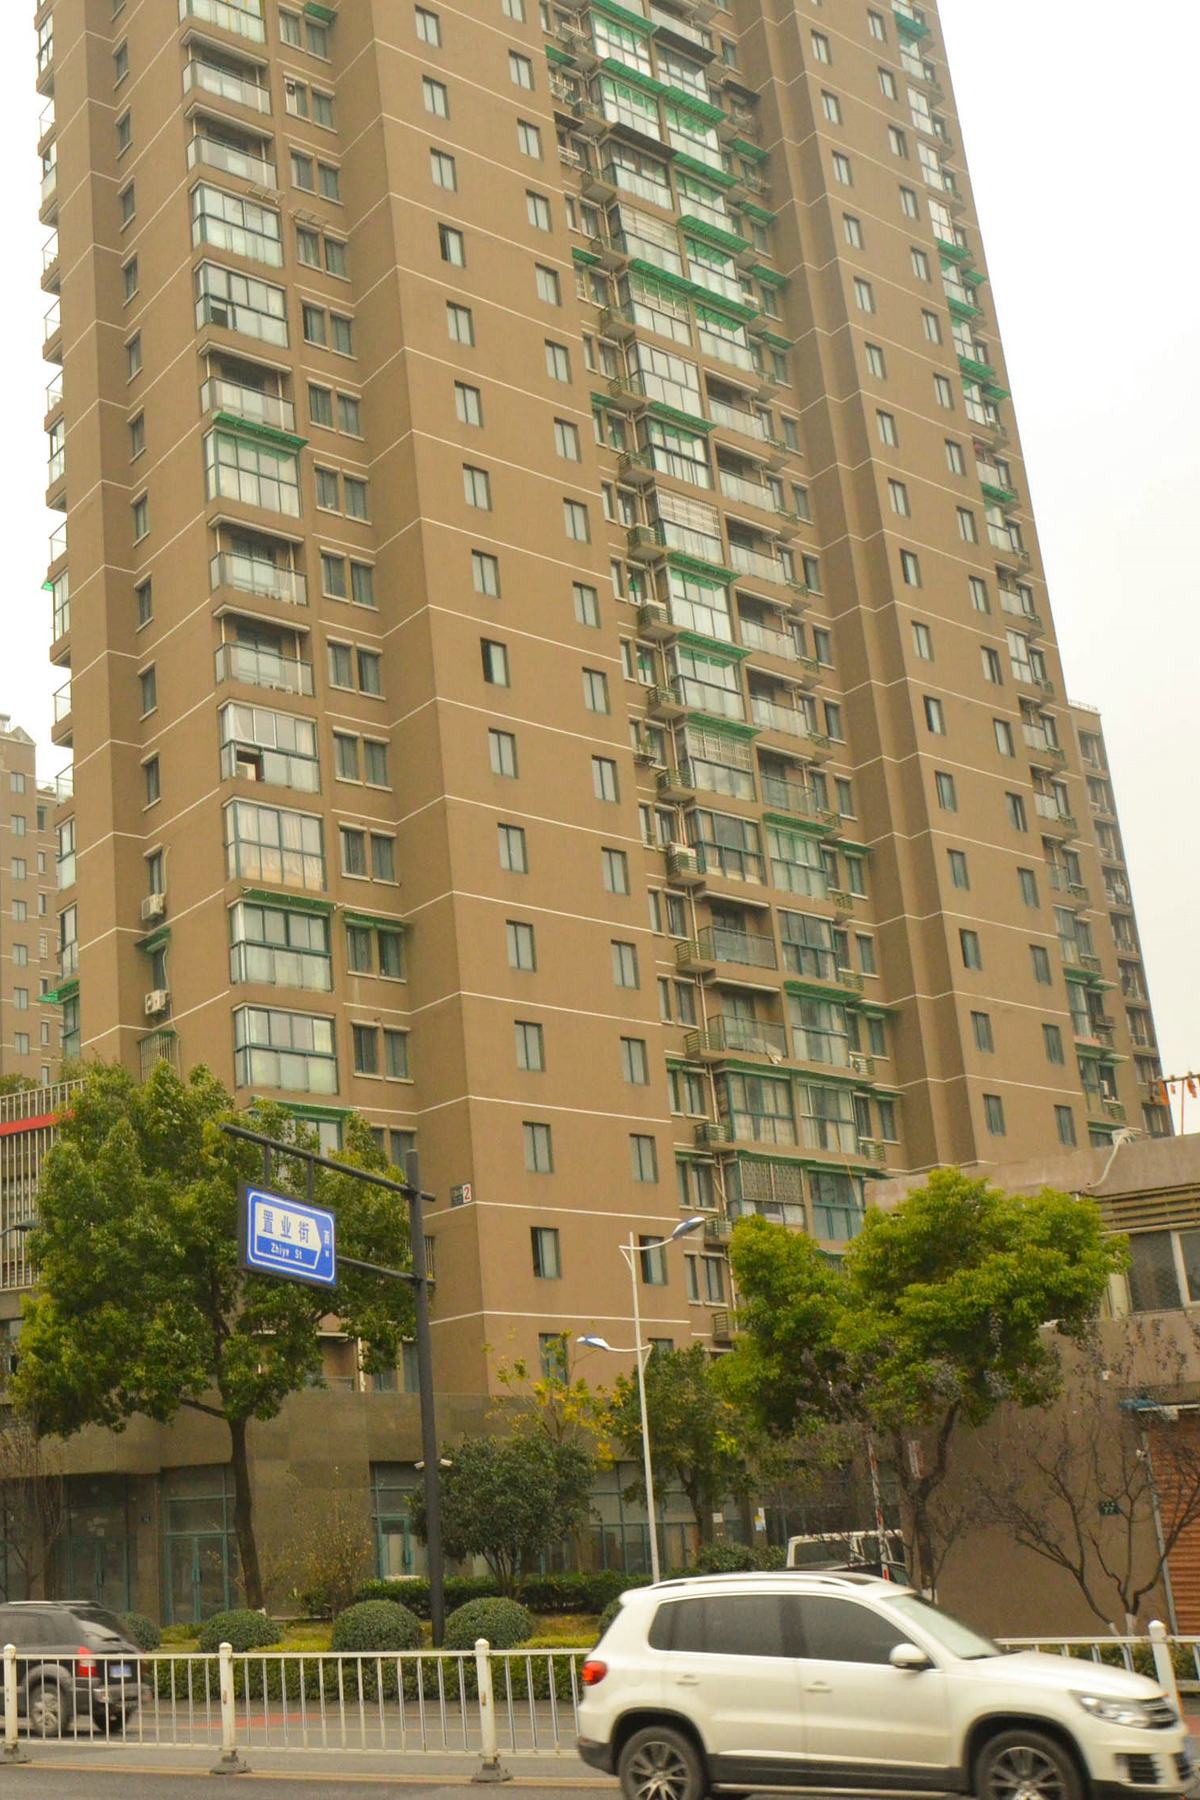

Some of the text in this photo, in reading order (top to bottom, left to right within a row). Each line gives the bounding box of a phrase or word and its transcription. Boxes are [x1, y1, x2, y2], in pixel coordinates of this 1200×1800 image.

[263, 1209, 310, 1244] 置业街
[270, 1242, 303, 1259] Zhiye St
